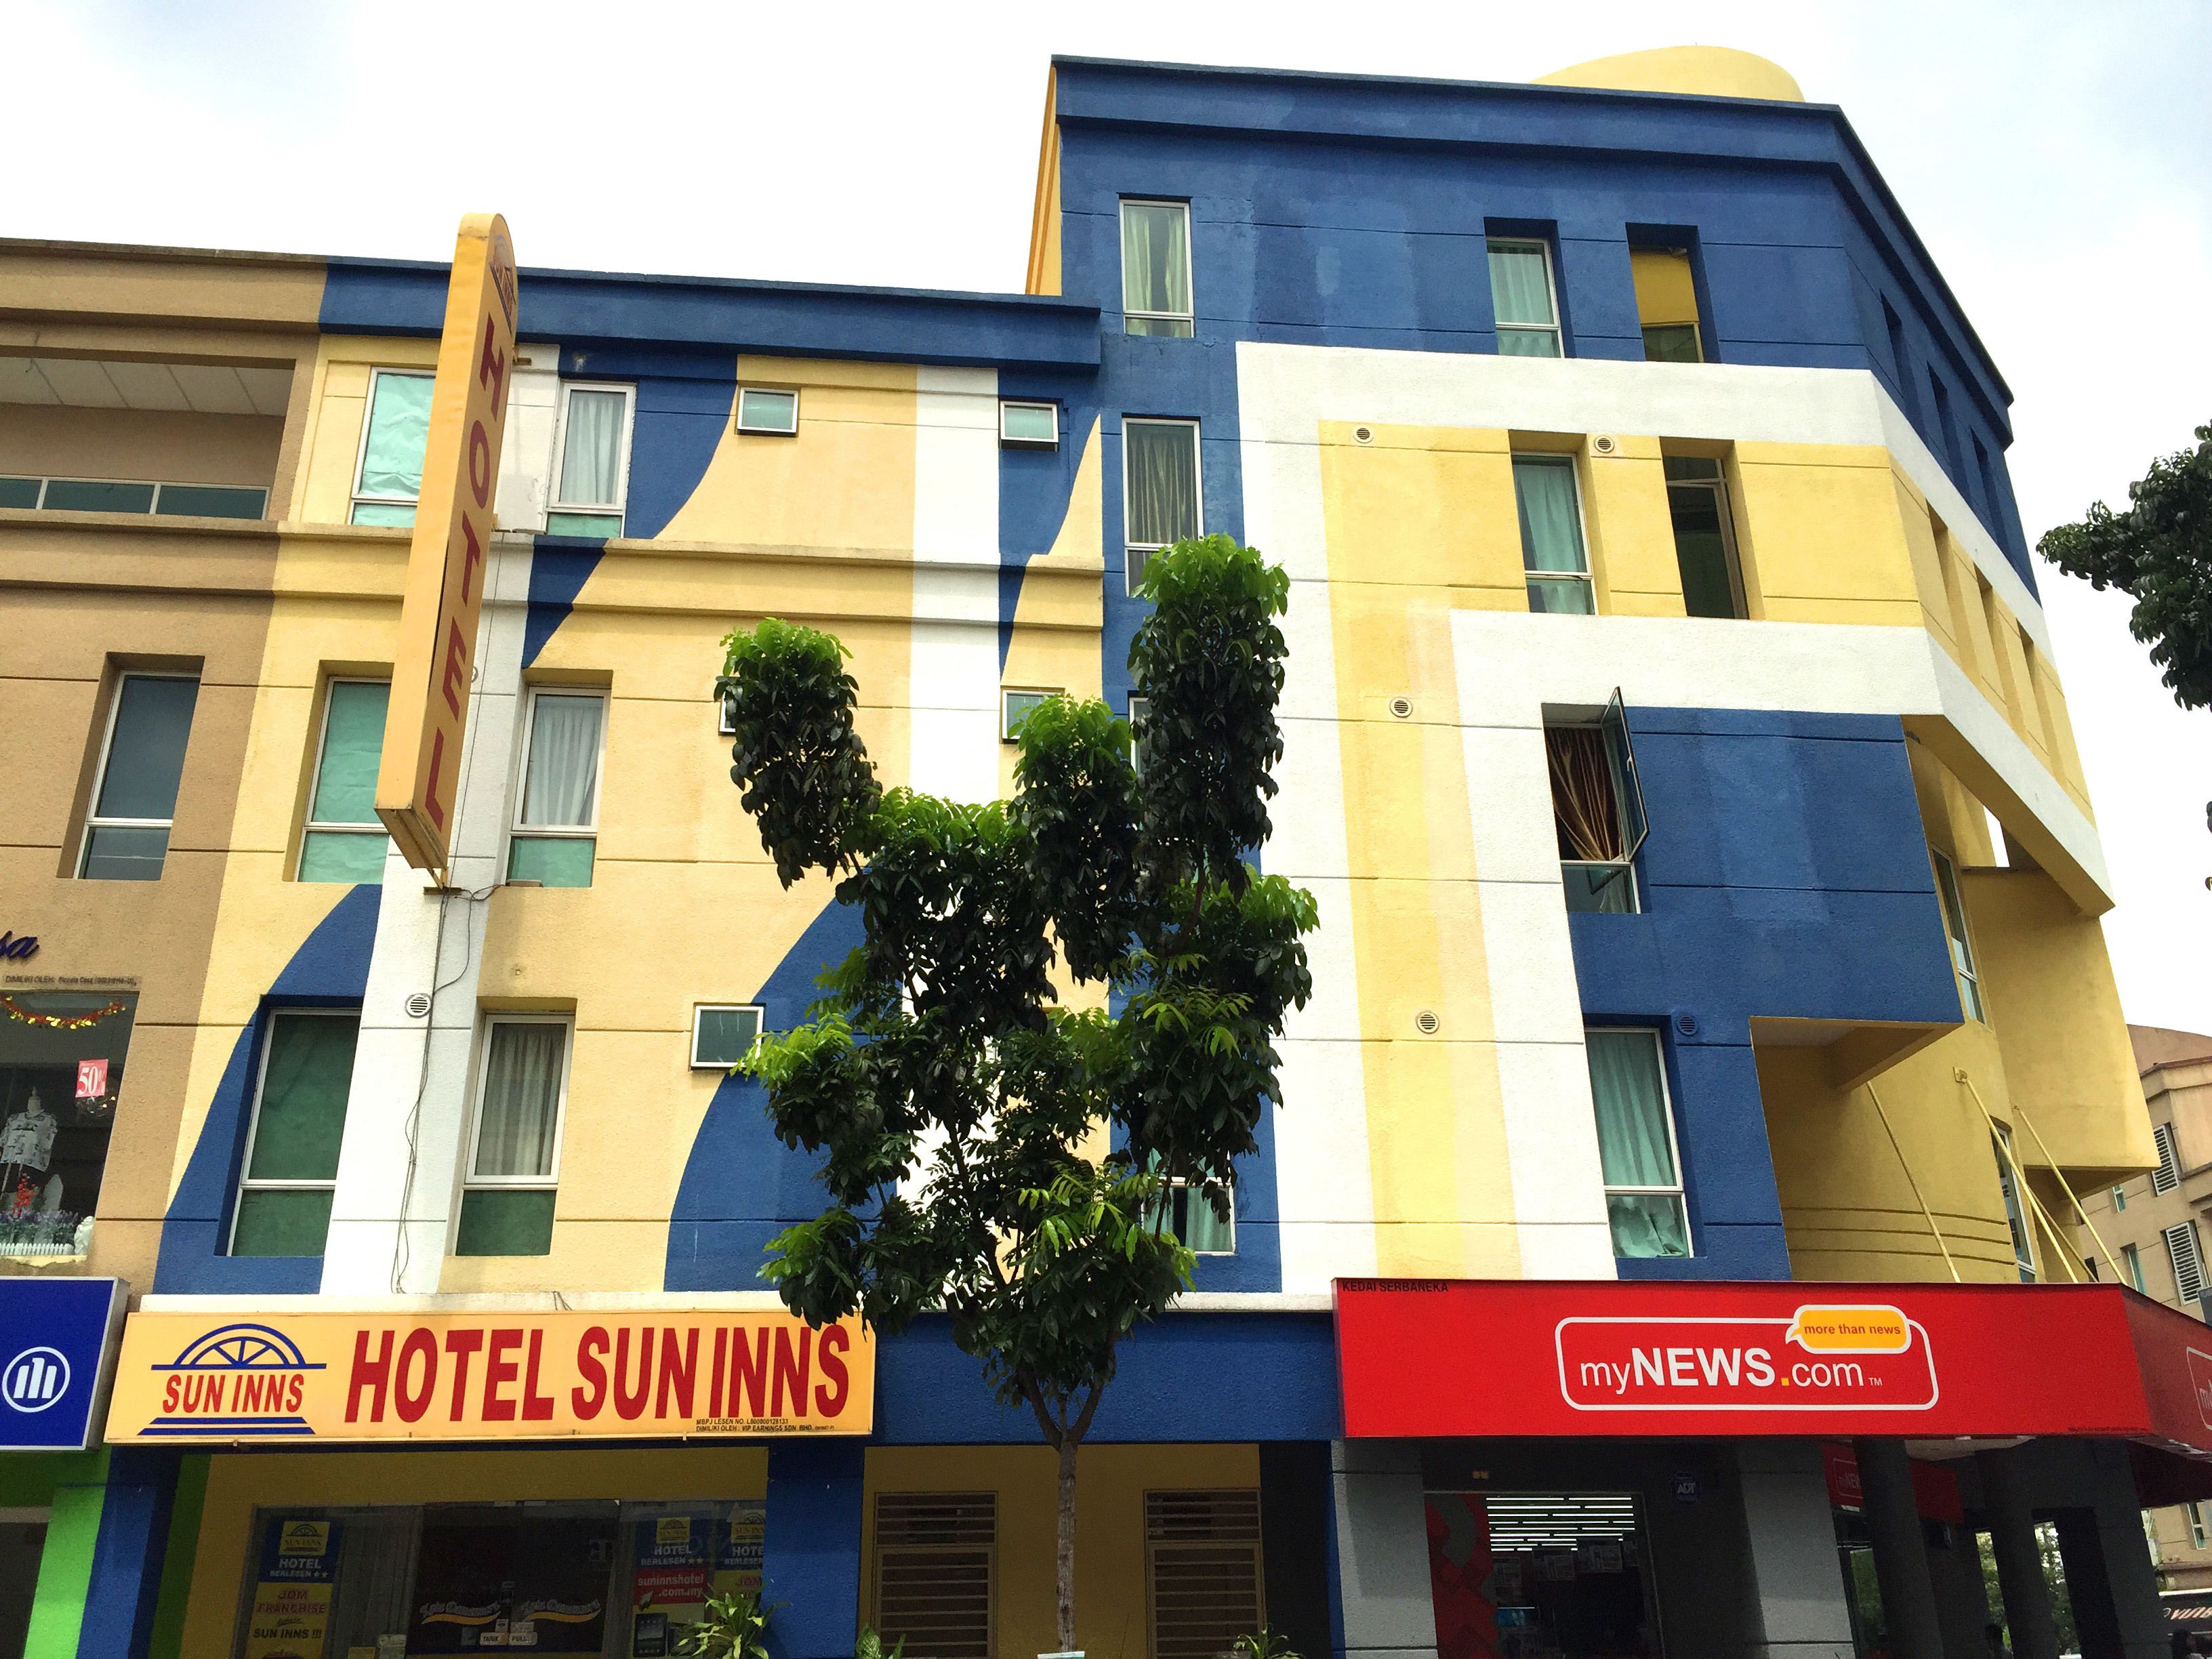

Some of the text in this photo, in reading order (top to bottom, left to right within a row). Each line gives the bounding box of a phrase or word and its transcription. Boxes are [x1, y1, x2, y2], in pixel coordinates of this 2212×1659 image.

[425, 312, 504, 832] HOTEL
[1343, 1281, 1449, 1292] KEDAI SERBANEKA
[1804, 1323, 1901, 1334] more than news
[344, 1324, 850, 1422] HOTEL SUN INNS
[1580, 1347, 1864, 1395] myNEWS.com
[163, 1374, 304, 1413] SUN INNS
[1677, 1482, 1696, 1494] ADT
[654, 1545, 692, 1555] HOTEL
[279, 1558, 322, 1570] HOTEL
[640, 1557, 686, 1566] BERLESEN
[638, 1573, 704, 1586] suninnshotel
[278, 1589, 308, 1600] JOM
[258, 1603, 327, 1614] FRANCHISE
[253, 1629, 277, 1639] SUN
[280, 1629, 309, 1639] INNS
